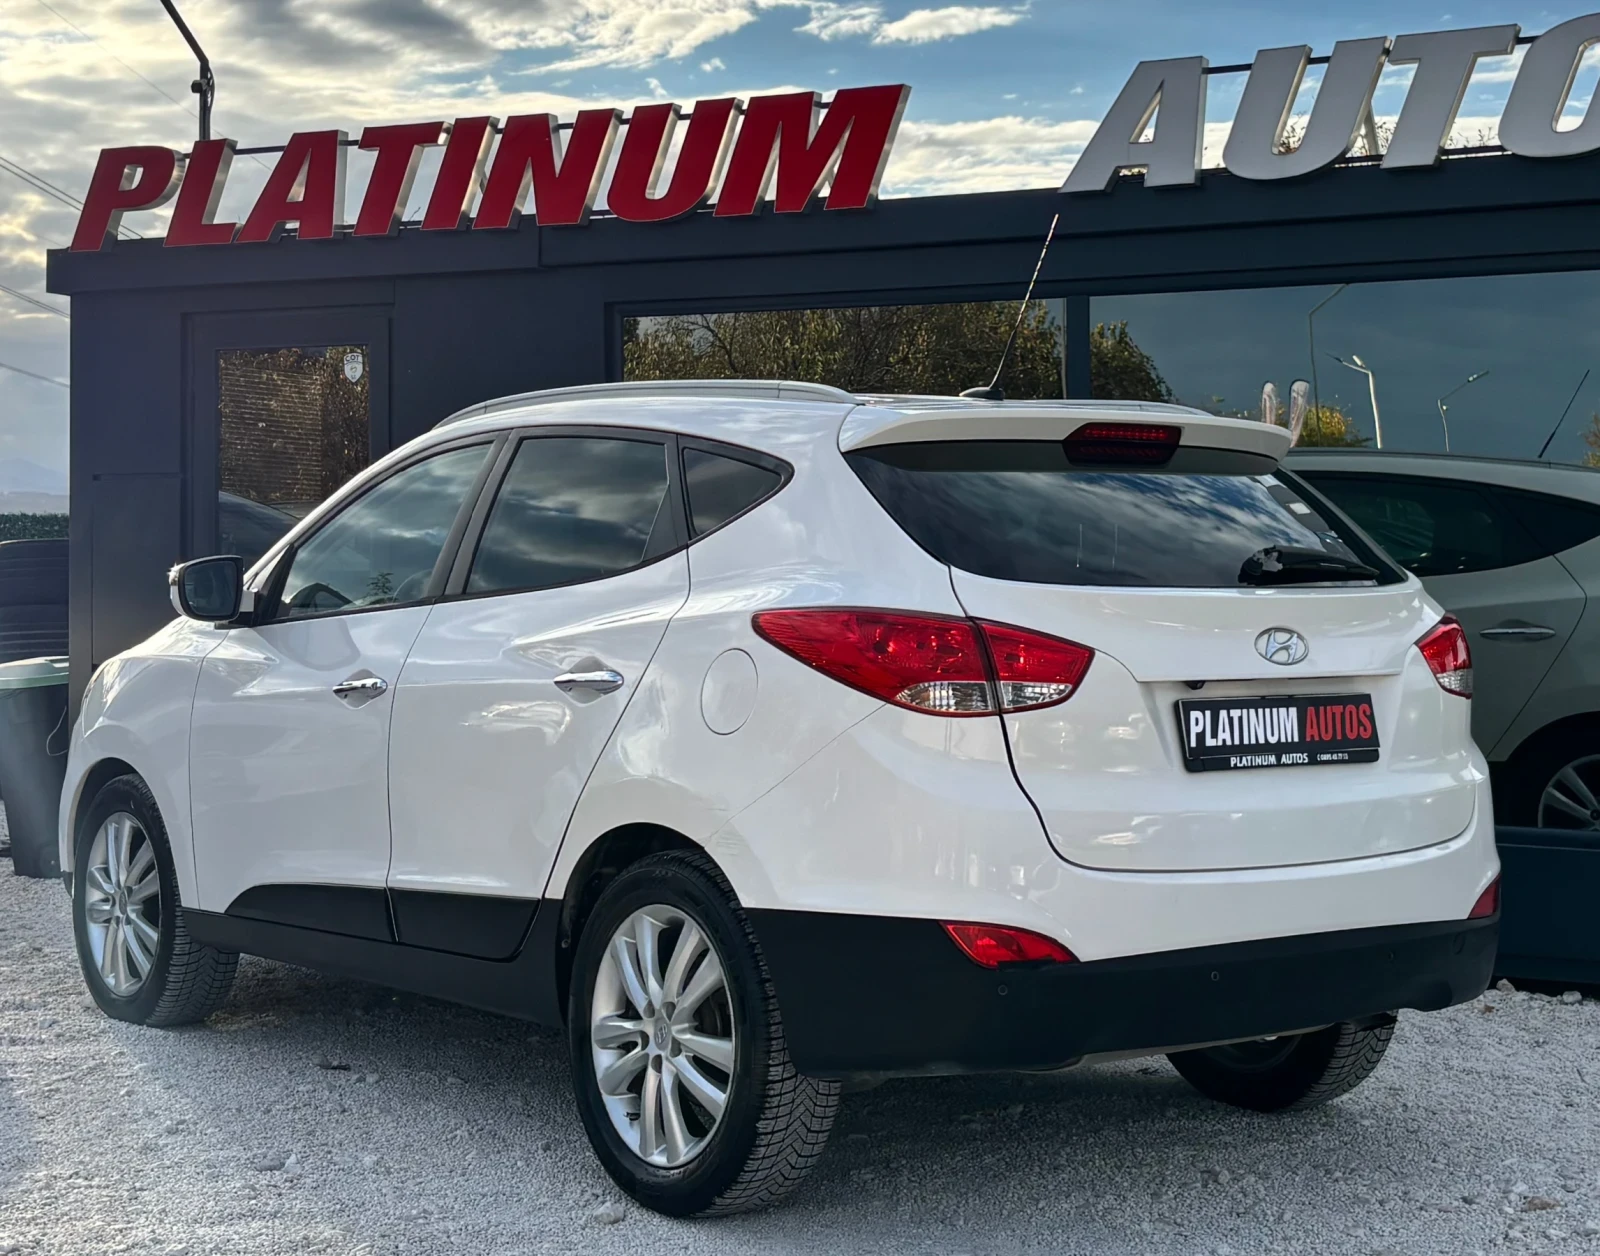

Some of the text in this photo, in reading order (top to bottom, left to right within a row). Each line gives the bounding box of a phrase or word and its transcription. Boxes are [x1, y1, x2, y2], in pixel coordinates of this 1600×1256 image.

[70, 13, 1600, 252] PLATINUM AUTO
[1189, 703, 1373, 747] PLATINUM AUTOS
[1230, 755, 1277, 767] PLATINUM
[1280, 753, 1309, 764] AUTOS
